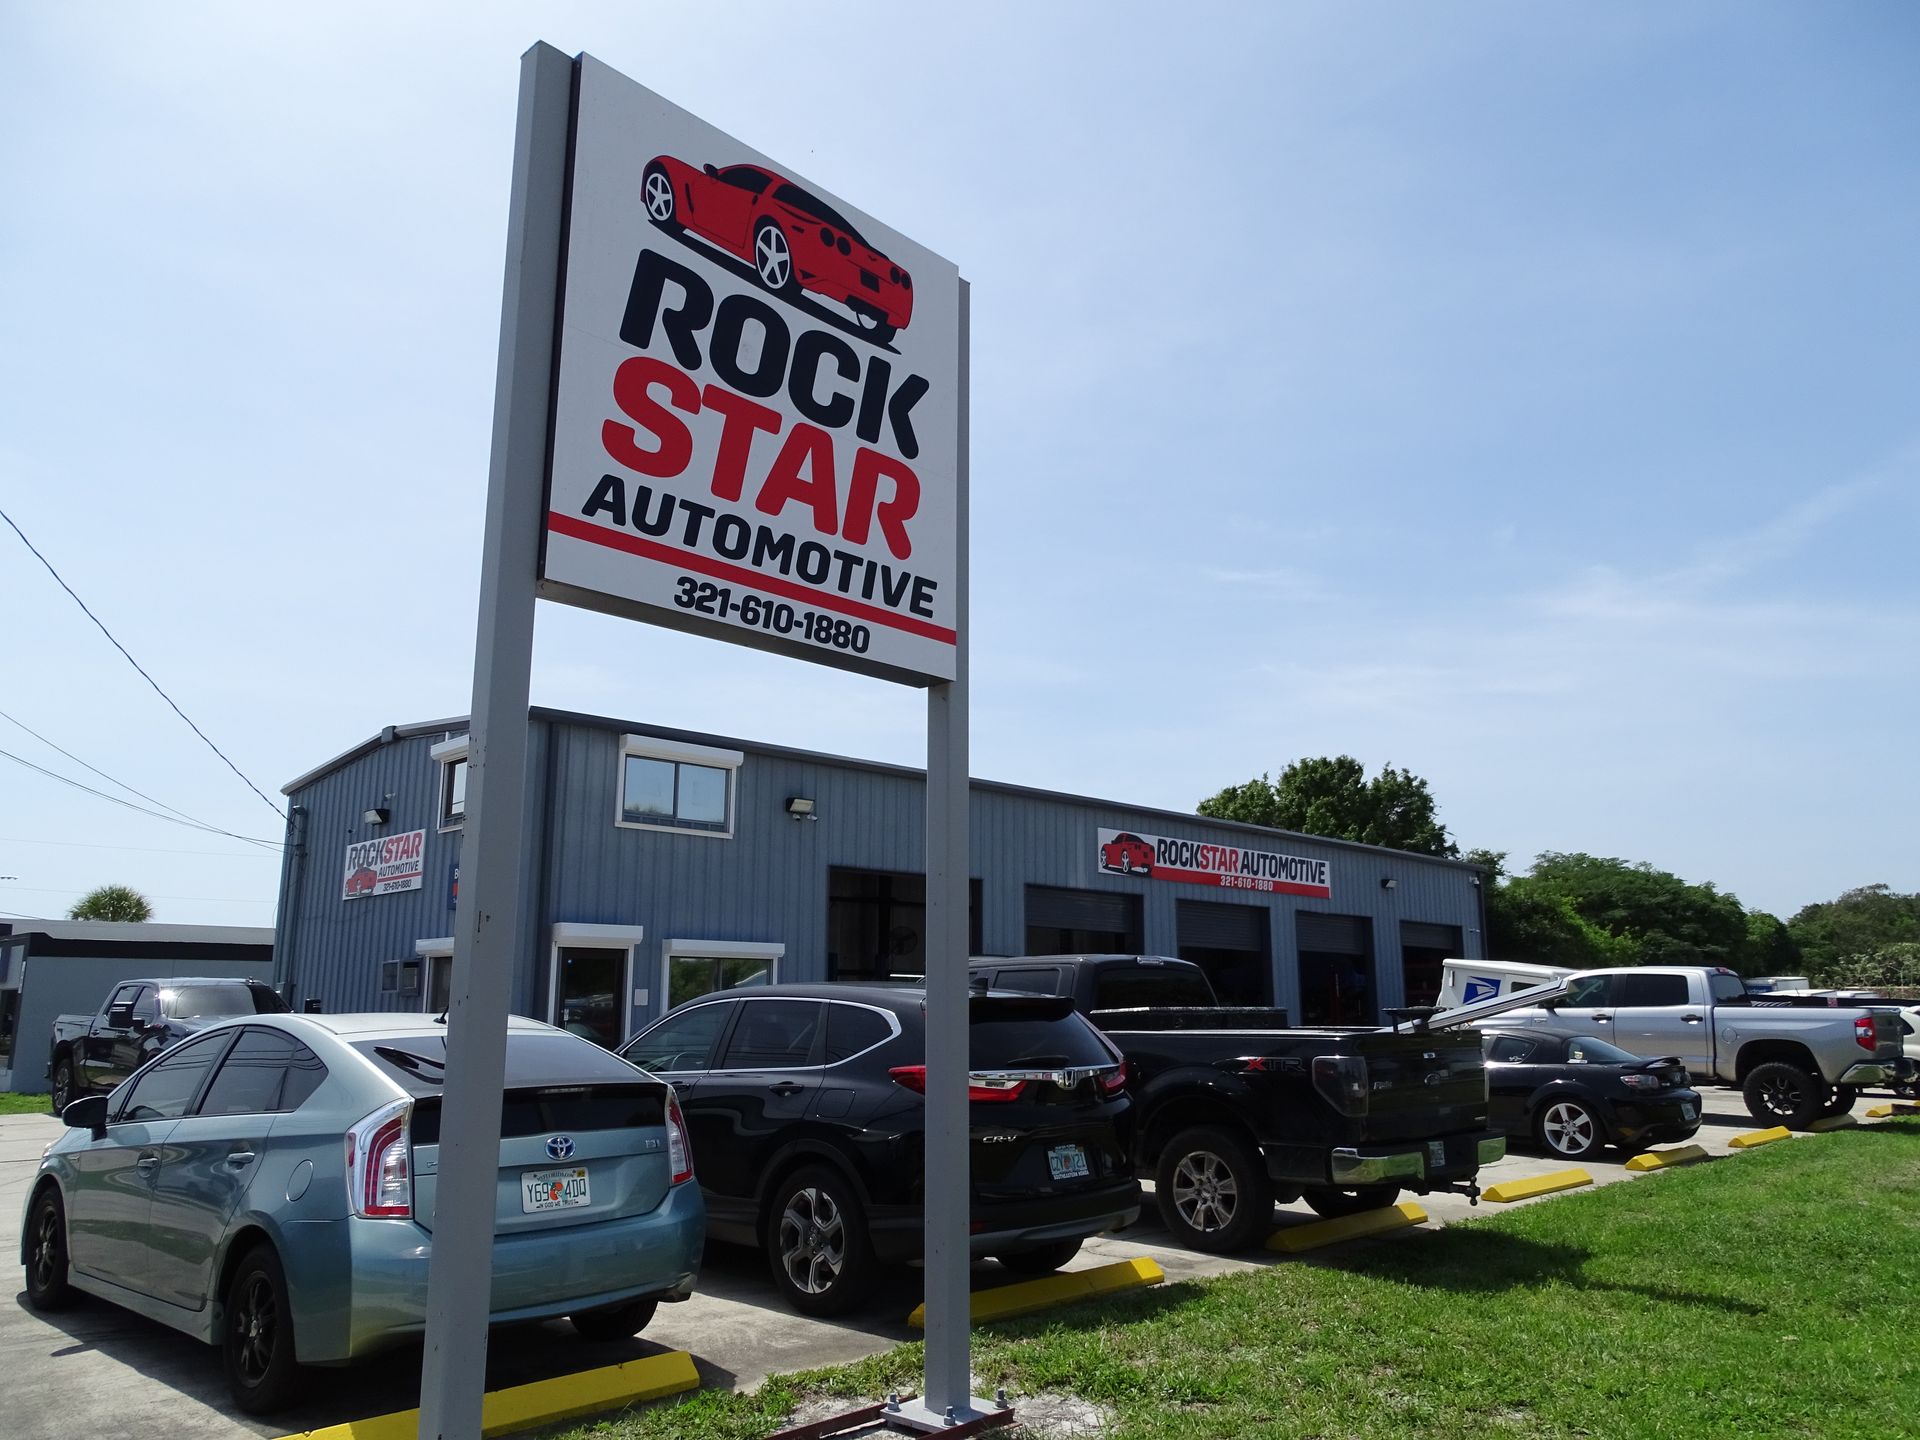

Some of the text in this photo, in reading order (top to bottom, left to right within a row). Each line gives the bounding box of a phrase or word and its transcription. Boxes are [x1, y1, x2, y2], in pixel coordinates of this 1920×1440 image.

[619, 248, 930, 460] ROCK
[601, 356, 921, 560] STAR
[581, 473, 938, 619] AUTOMOTIVE
[673, 576, 870, 653] 321-610-1880
[347, 832, 423, 871] ROCKSTAR
[378, 860, 420, 877] AUTOMOTIVE
[1155, 838, 1326, 884] ROCKSTAR AUTOMOTIVE
[383, 879, 412, 892] 321-610-1880
[1220, 875, 1274, 891] 321-610-1880
[982, 1134, 1017, 1143] CR-V
